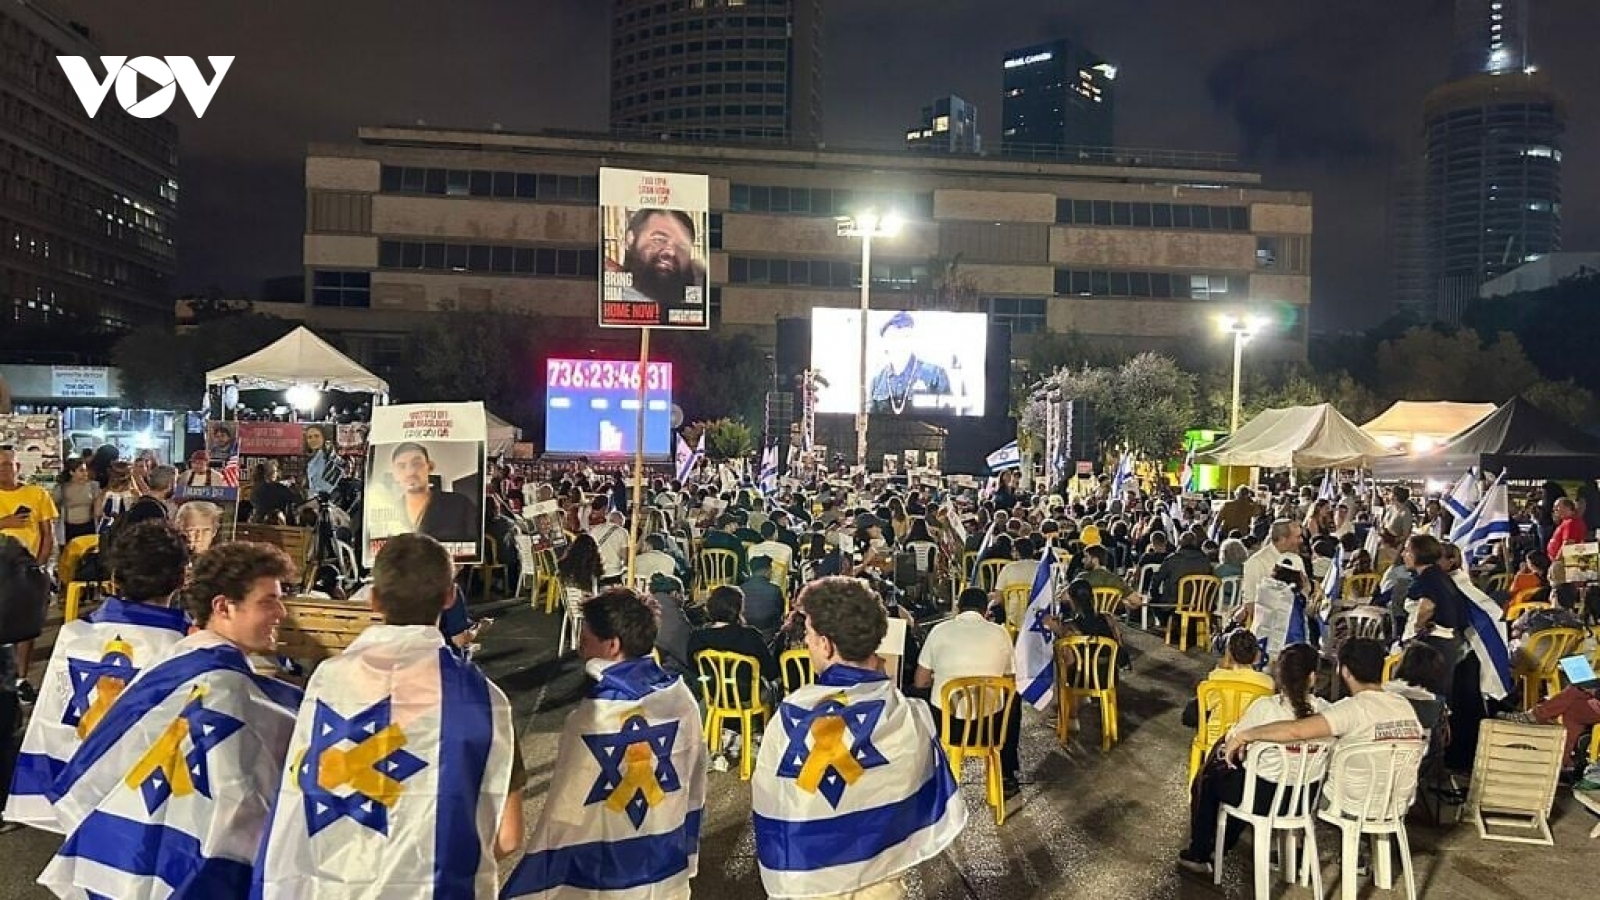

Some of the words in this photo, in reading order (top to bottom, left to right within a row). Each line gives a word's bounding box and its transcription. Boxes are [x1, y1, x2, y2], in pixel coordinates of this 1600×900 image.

[604, 271, 634, 287] BRING
[604, 302, 631, 318] HOME
[632, 303, 660, 319] NOW!
[549, 362, 668, 390] 736:23:4631
